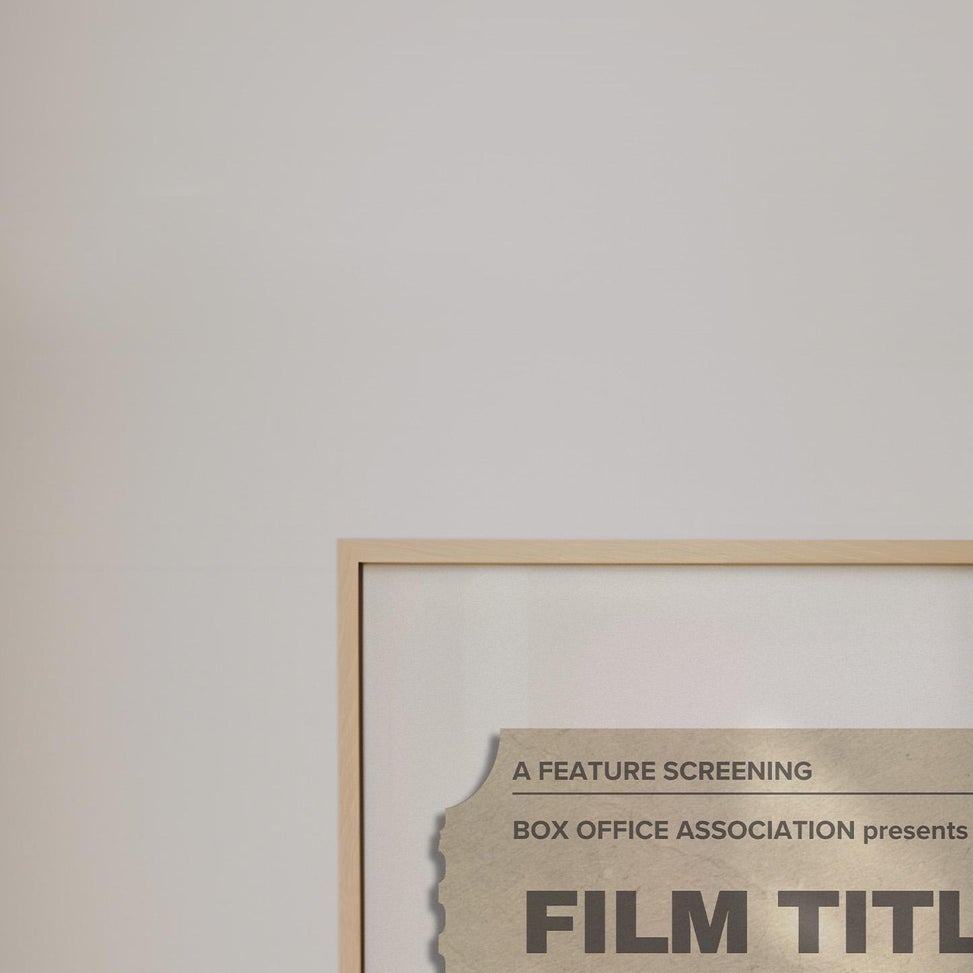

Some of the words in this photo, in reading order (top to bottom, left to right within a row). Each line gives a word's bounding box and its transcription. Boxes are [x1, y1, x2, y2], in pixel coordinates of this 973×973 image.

[511, 760, 532, 781] A
[538, 760, 656, 781] FEATURE
[663, 760, 813, 781] SCREENING
[513, 820, 570, 840] BOX
[576, 819, 669, 841] OFFICE
[675, 819, 856, 841] ASSOCIATION
[863, 821, 969, 845] presents
[525, 890, 748, 954] FILM
